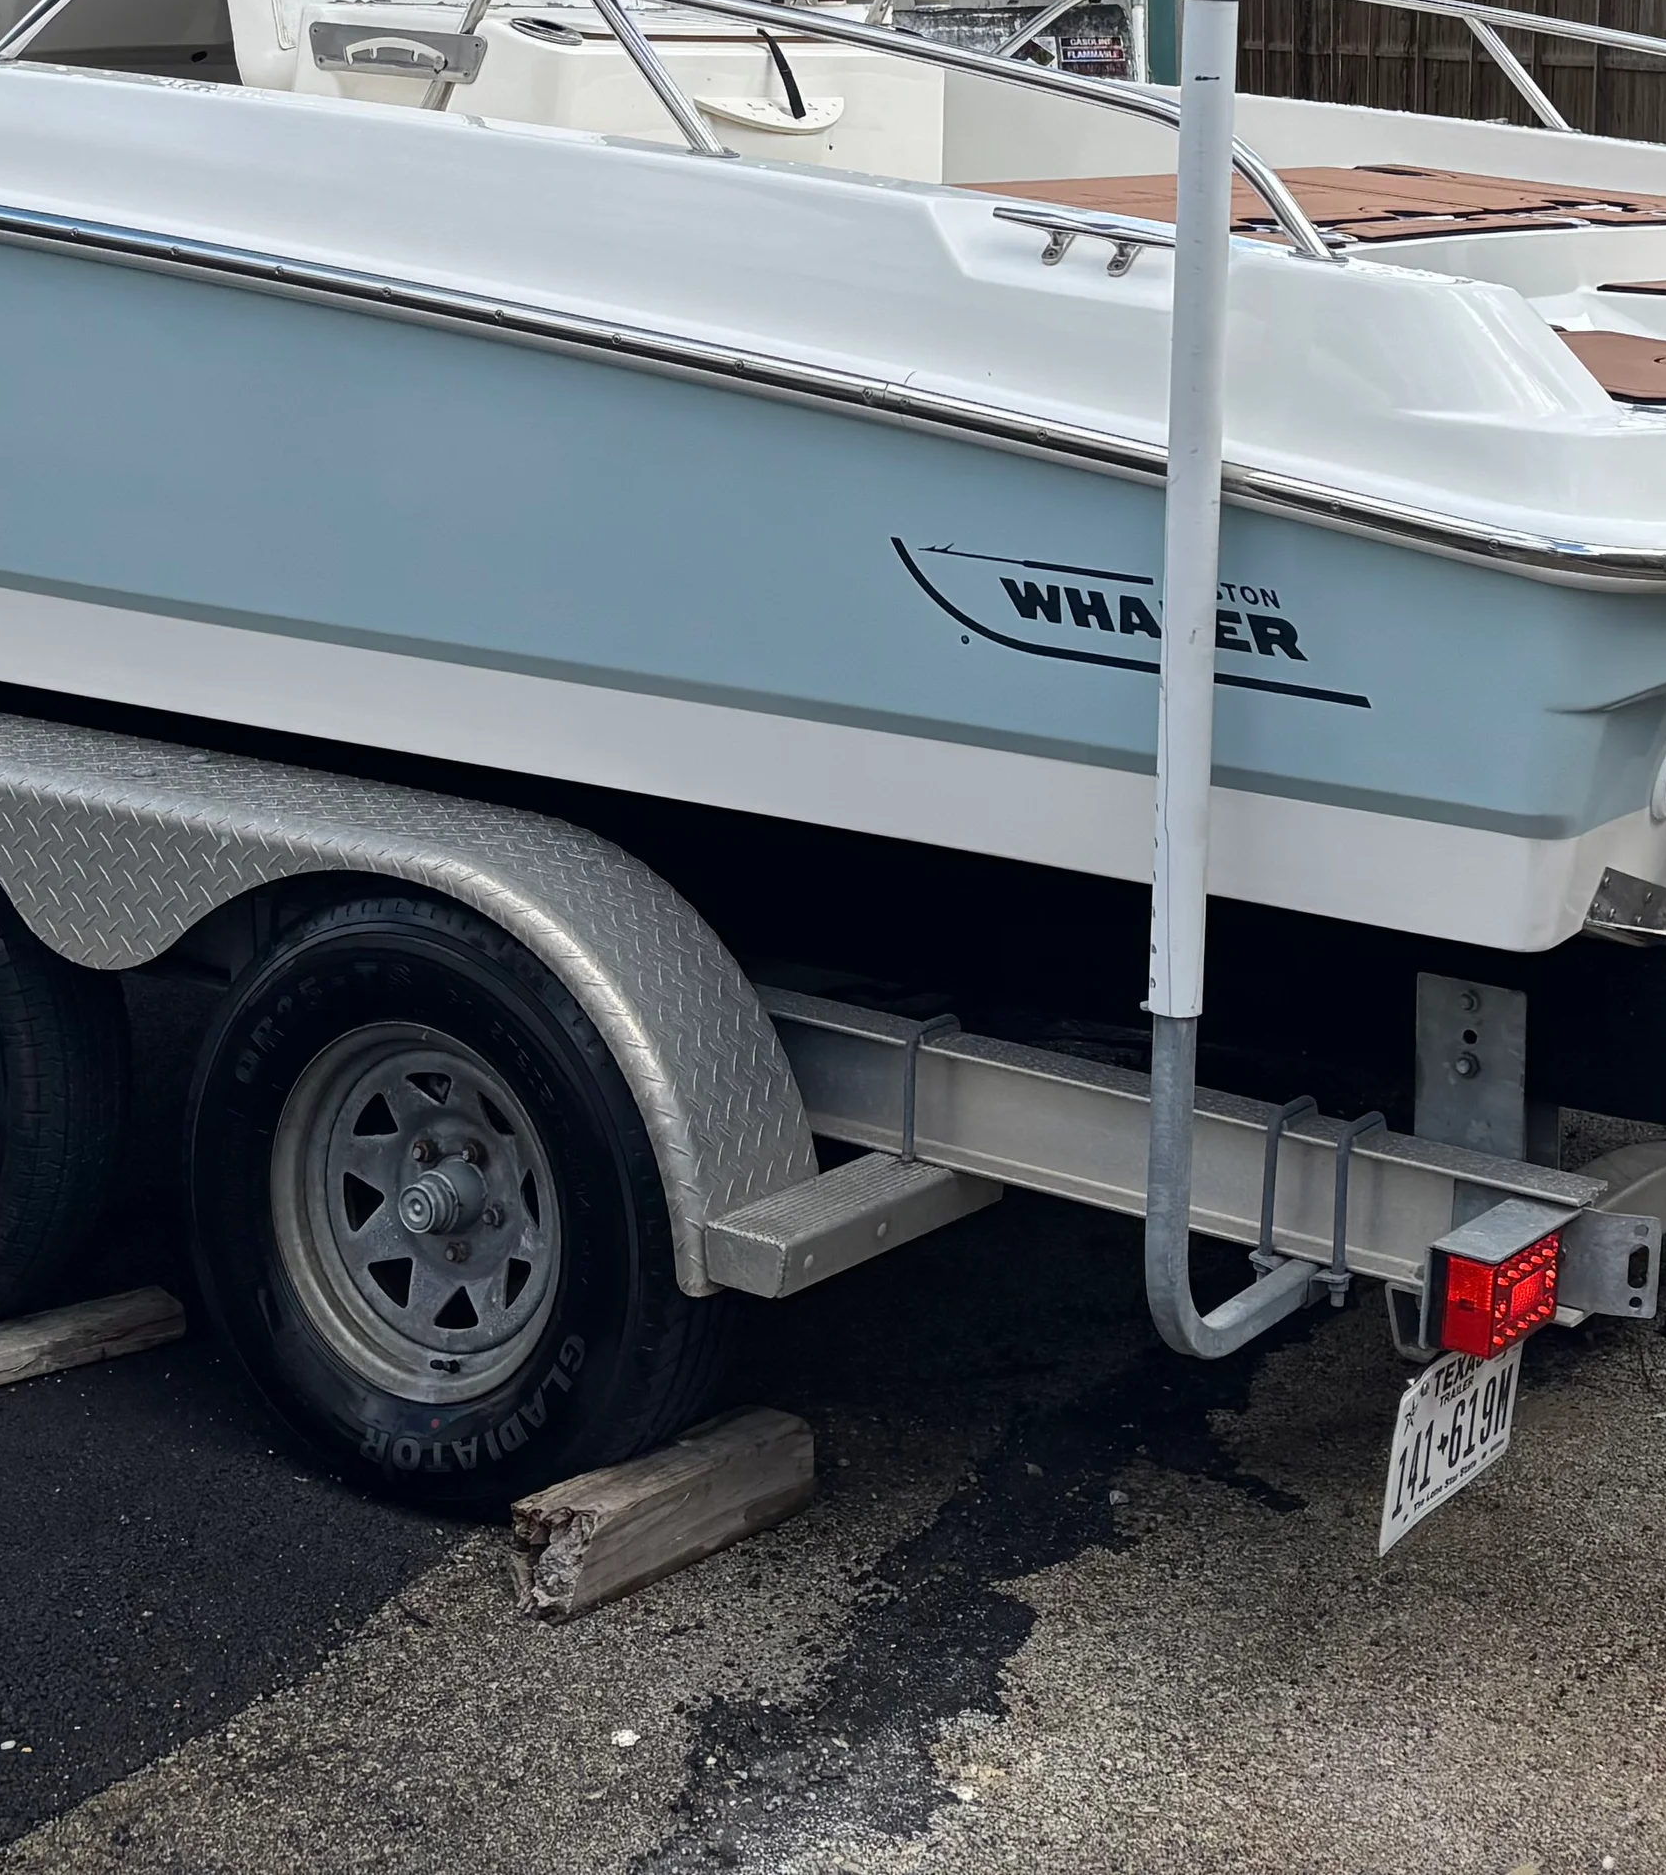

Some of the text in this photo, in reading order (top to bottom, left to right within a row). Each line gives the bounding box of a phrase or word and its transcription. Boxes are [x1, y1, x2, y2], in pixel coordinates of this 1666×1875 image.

[1067, 50, 1120, 59] FLAMMABLE
[1069, 37, 1112, 46] GASOLINE
[998, 576, 1309, 662] WHAER
[358, 1333, 587, 1473] GLADIATOR
[1439, 1375, 1475, 1409] TRAILER
[1391, 1363, 1514, 1521] 141 619M
